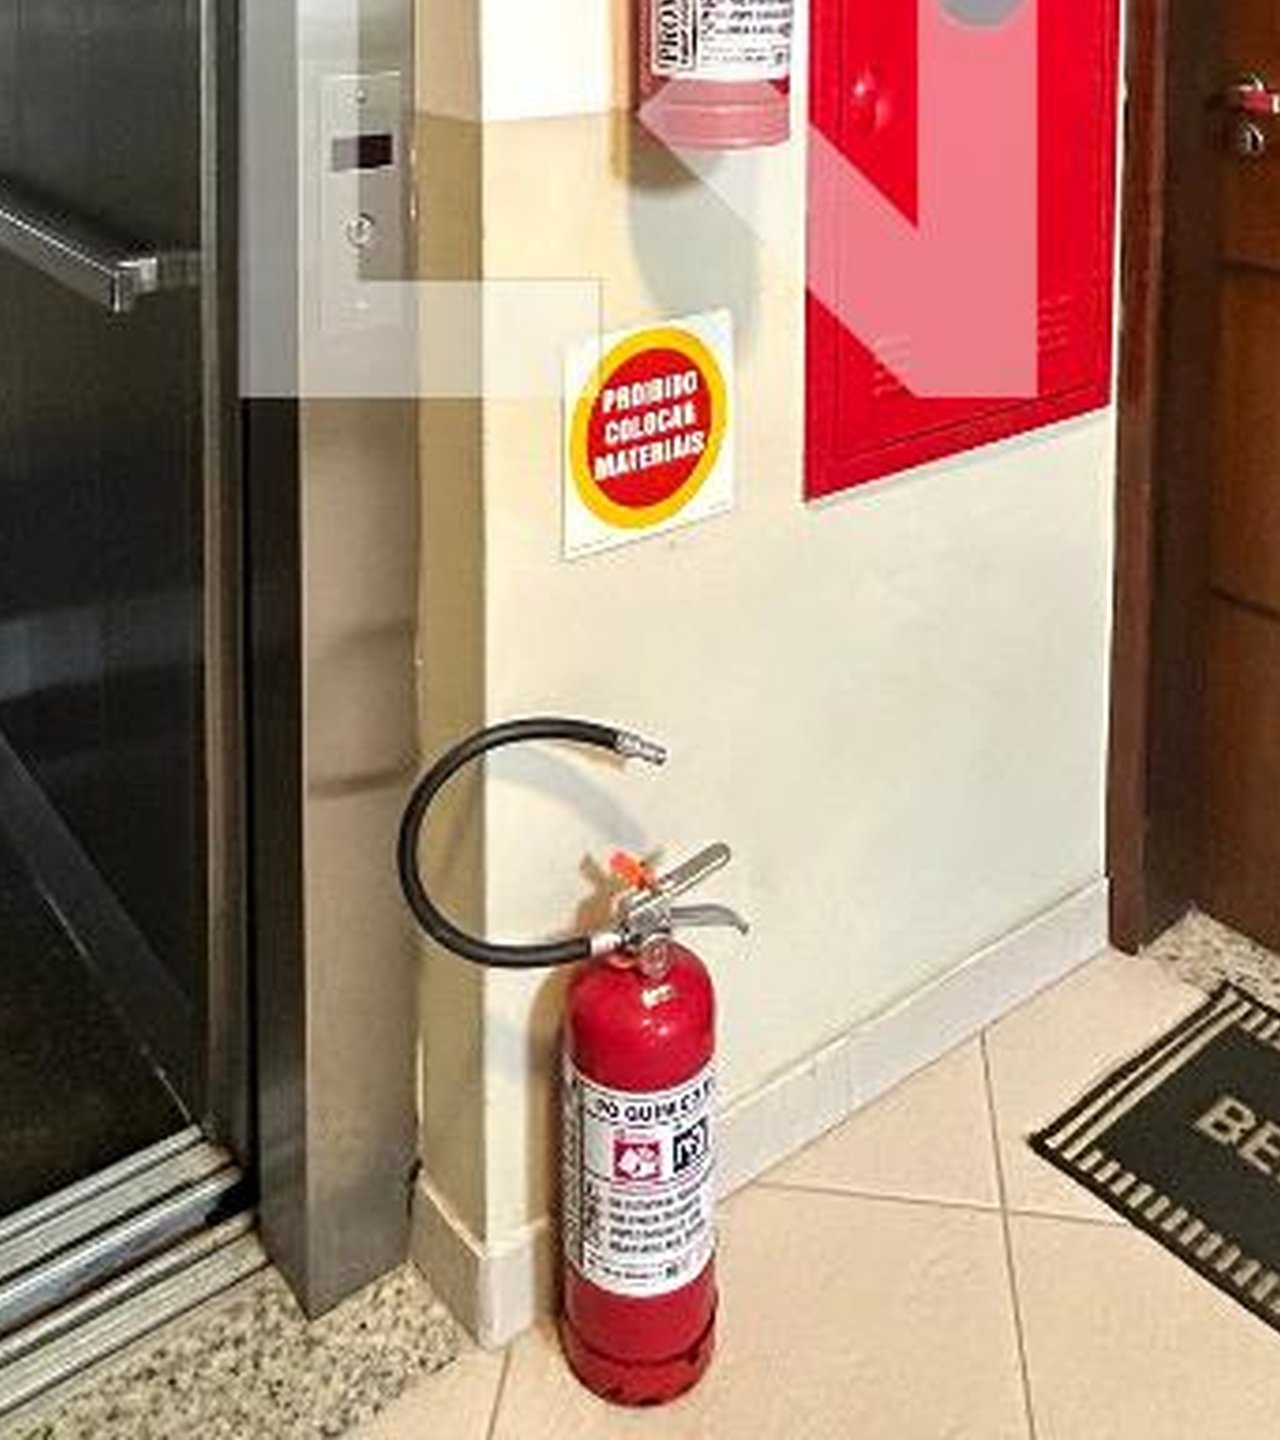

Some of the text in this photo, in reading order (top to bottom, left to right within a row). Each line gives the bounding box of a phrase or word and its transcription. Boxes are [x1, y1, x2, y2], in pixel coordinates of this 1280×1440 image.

[601, 370, 698, 414] PROIBIDO
[604, 401, 697, 445] COLOCAR
[594, 431, 706, 481] MATERIAIS
